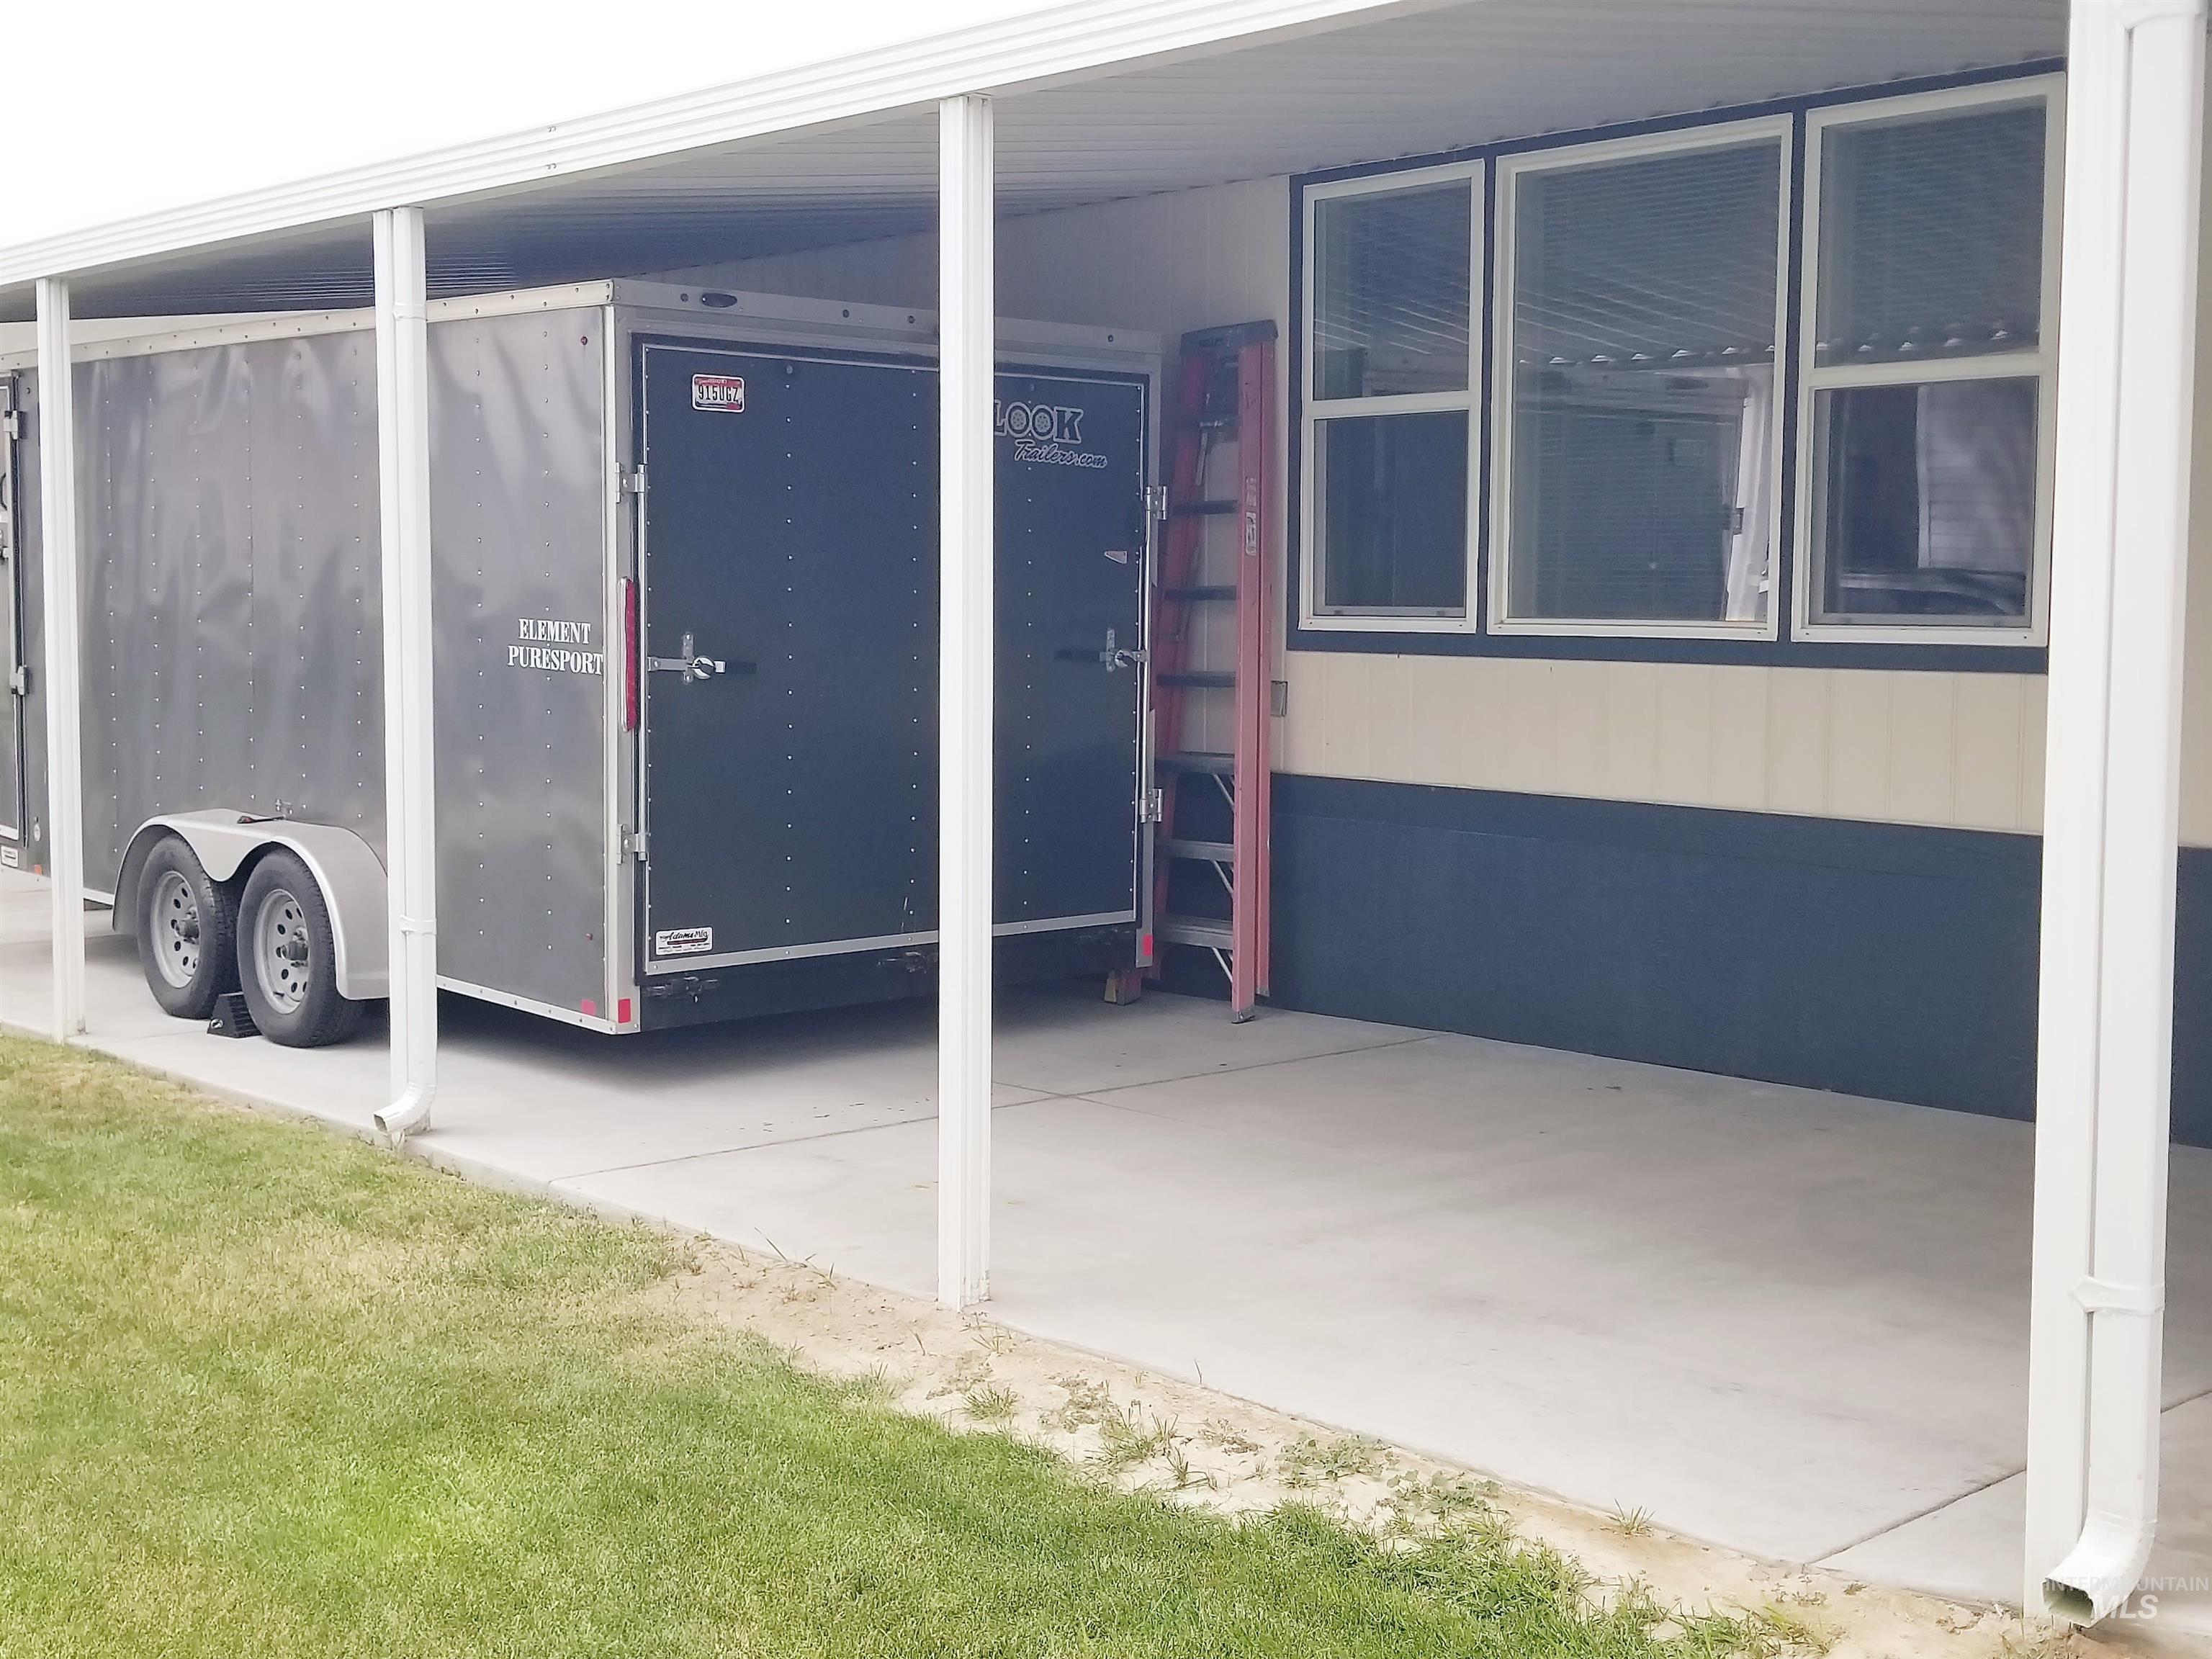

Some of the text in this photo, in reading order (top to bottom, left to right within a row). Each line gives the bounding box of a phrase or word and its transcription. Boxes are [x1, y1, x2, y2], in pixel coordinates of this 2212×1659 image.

[994, 400, 1084, 444] LOOK
[1014, 439, 1107, 468] Trailers.com
[518, 618, 591, 644] ELEMENT
[507, 645, 603, 675] PURESPORT
